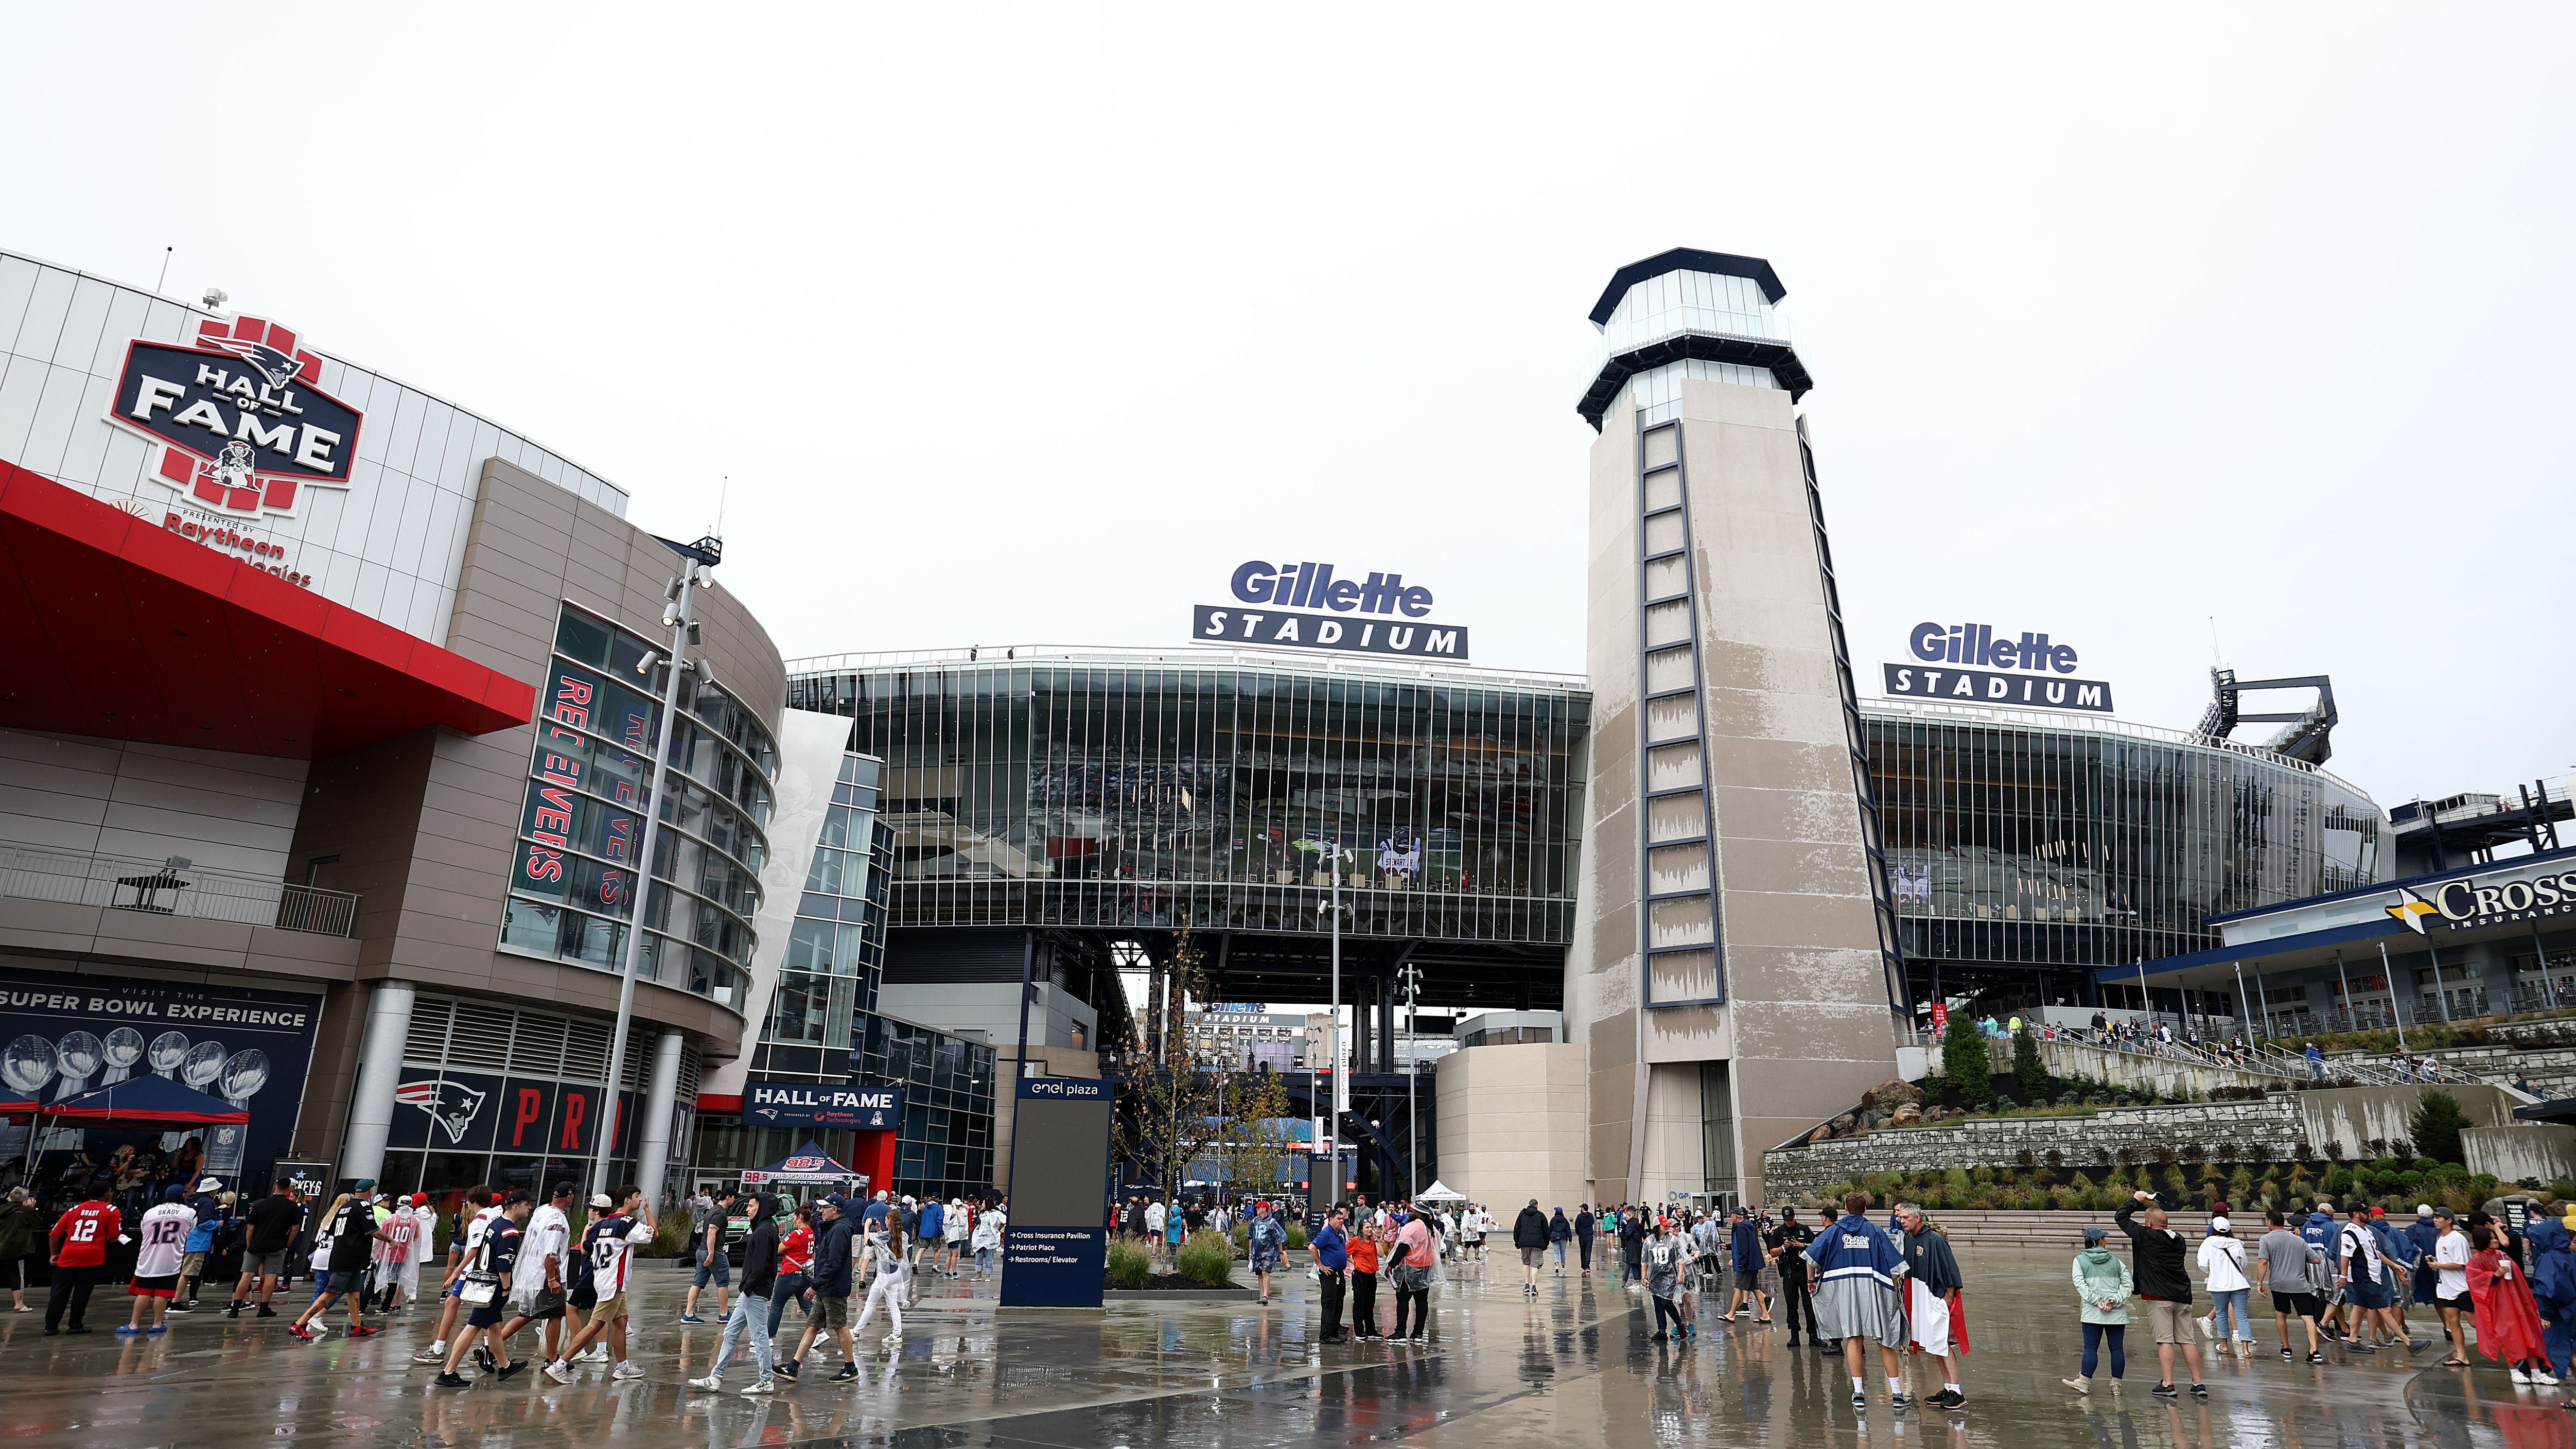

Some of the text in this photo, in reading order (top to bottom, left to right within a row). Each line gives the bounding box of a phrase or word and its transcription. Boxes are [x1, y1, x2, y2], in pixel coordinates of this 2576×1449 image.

[195, 363, 303, 414] HALL
[237, 397, 260, 411] OF
[131, 374, 341, 473] FAME
[183, 510, 238, 529] PRESENTED
[165, 513, 285, 558] Raytheon
[1231, 561, 1433, 618] Gillette
[1205, 611, 1457, 653] STADIUM
[1910, 622, 2077, 673] Gillette
[1895, 669, 2101, 707] STADIUM
[2437, 874, 2576, 920] CROSS
[2450, 905, 2572, 930] INSURANC
[122, 988, 165, 997] VISIT
[0, 991, 306, 1027] SUPER BOWL EXPERIENCE
[1204, 1015, 1270, 1023] STADIUM
[754, 1088, 818, 1105] HALL
[832, 1092, 893, 1108] FAME
[1032, 1081, 1097, 1096] enel plaza
[219, 1134, 233, 1143] NFL
[744, 1172, 768, 1182] 98.5
[335, 1217, 347, 1236] 88
[1119, 1214, 1128, 1223] 12
[1762, 1222, 1770, 1231] 12
[70, 1219, 98, 1242] 12
[152, 1221, 180, 1245] 12
[395, 1226, 410, 1243] 10
[594, 1242, 615, 1270] 12
[1652, 1246, 1669, 1265] 10
